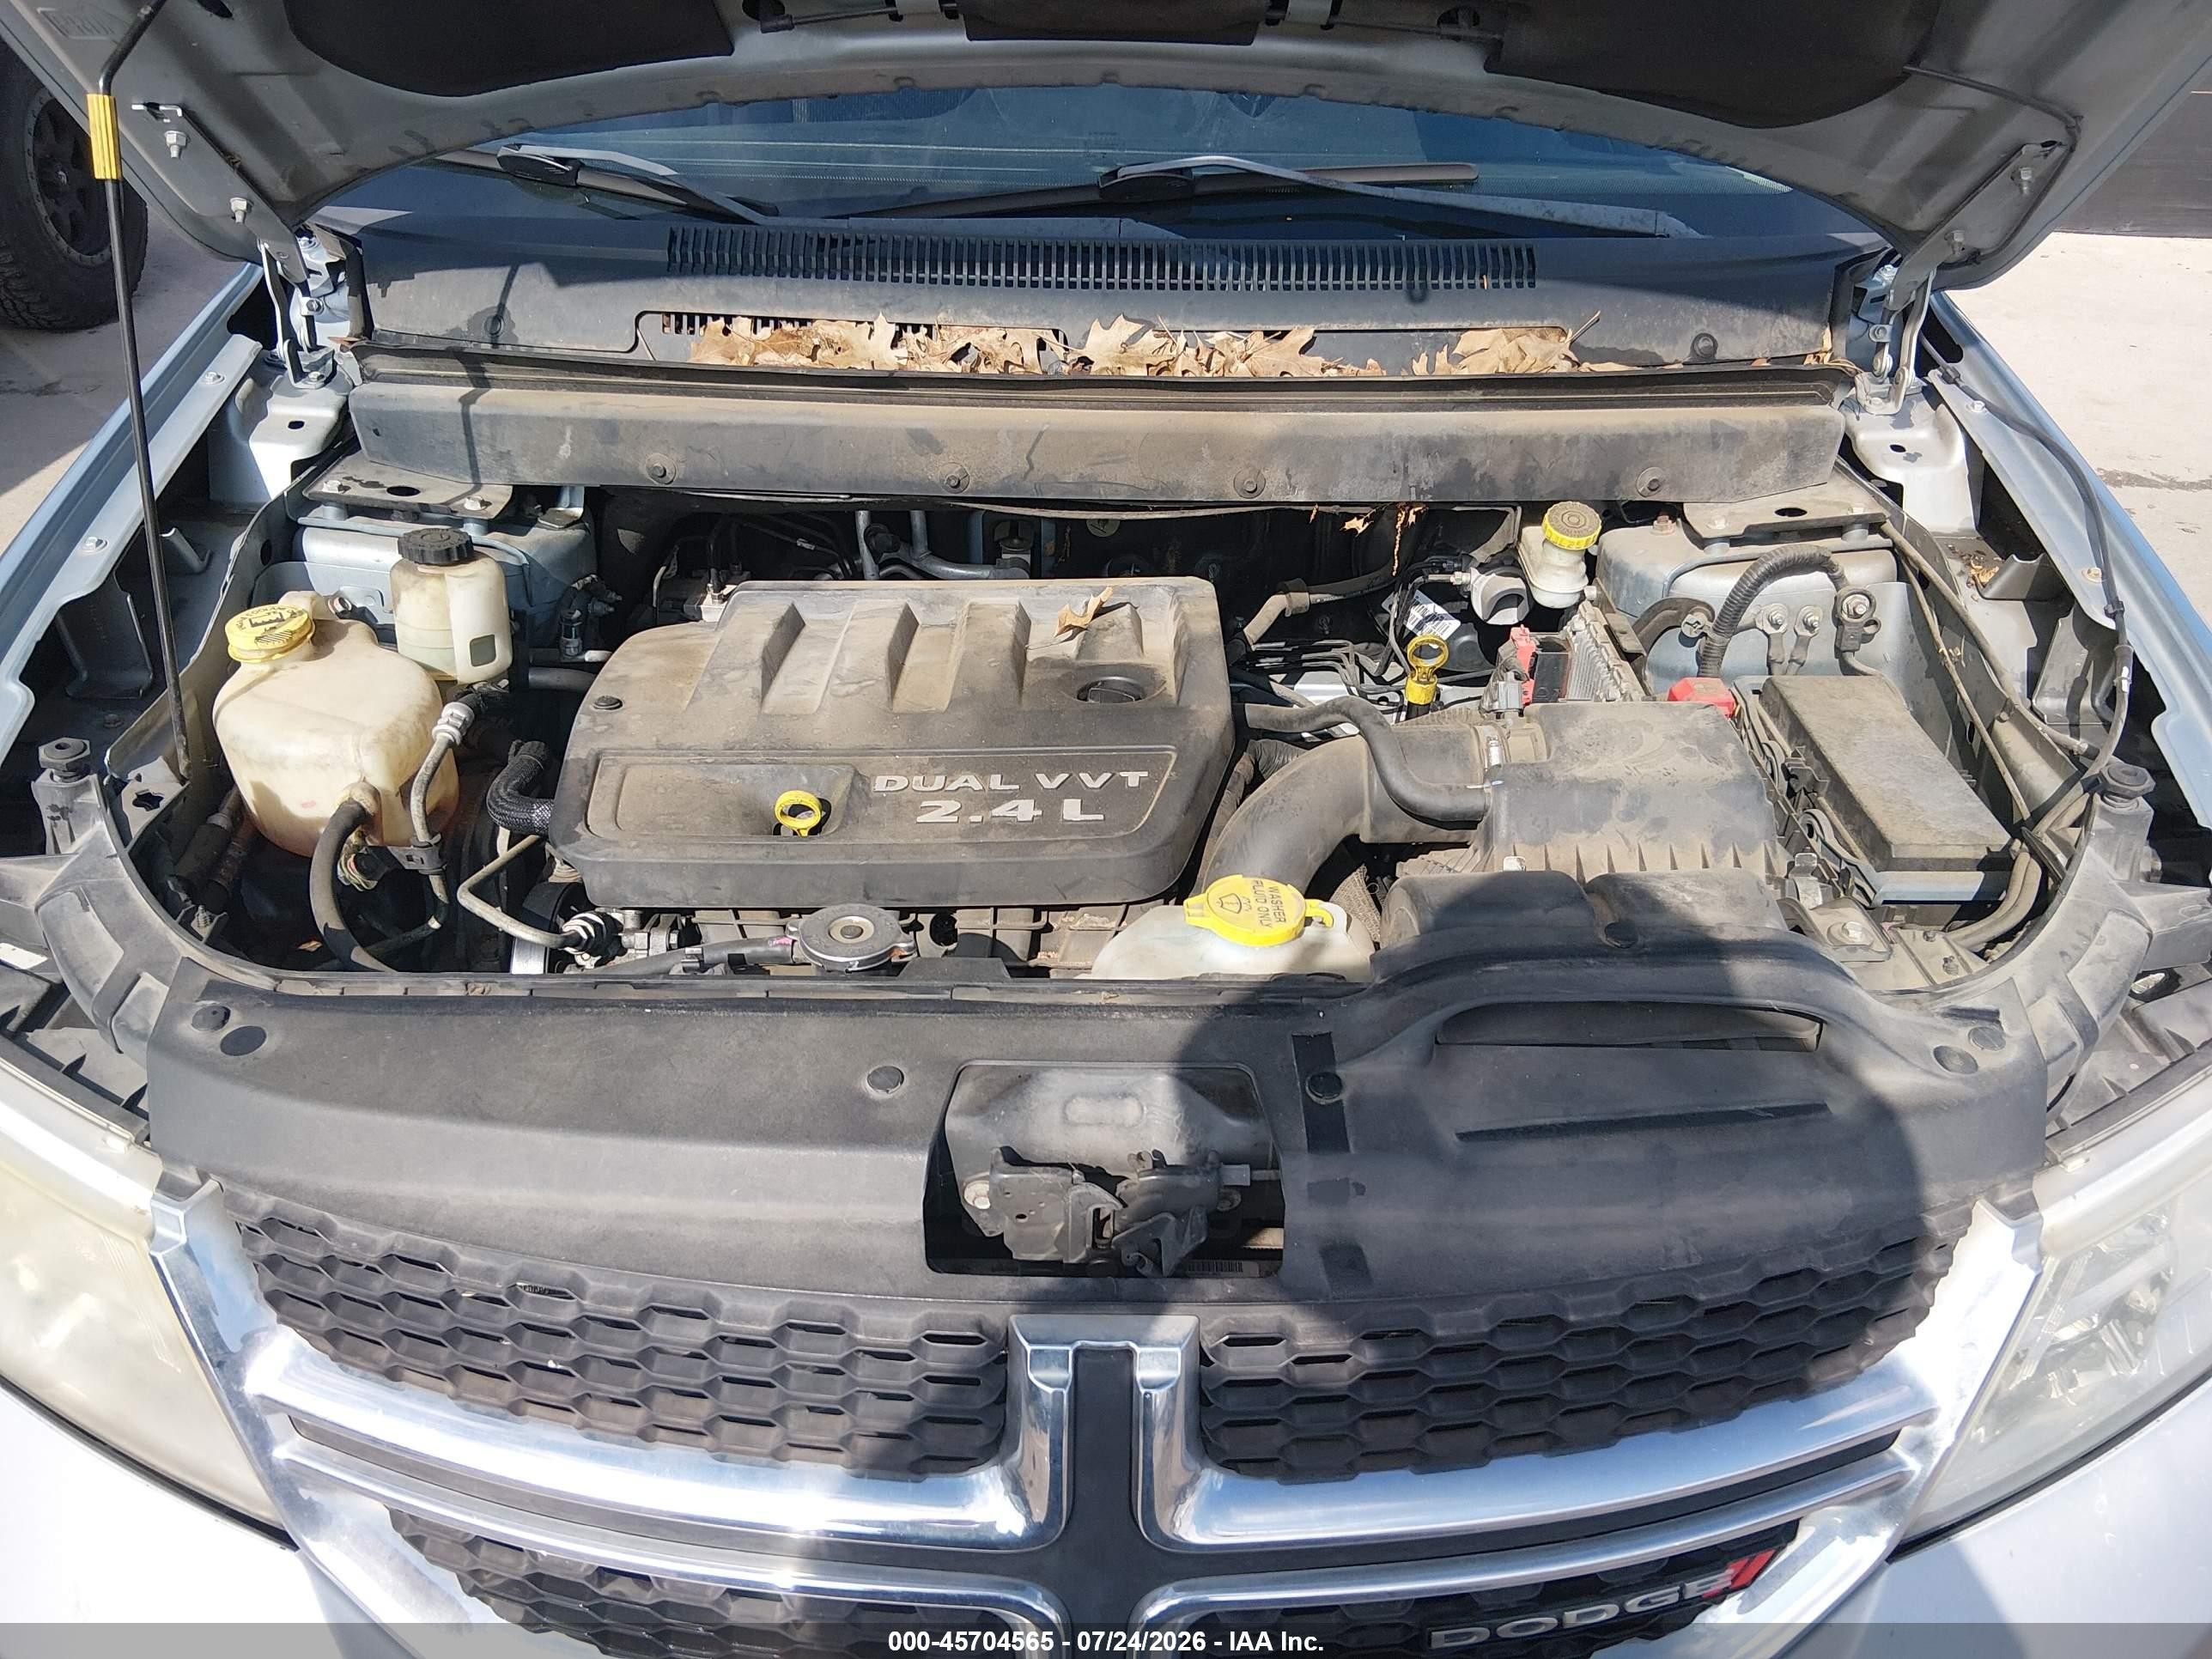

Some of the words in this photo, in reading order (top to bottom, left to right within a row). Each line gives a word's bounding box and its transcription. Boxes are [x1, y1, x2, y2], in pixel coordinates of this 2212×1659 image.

[872, 774, 1020, 792] DUAL
[1035, 771, 1149, 790] VVT
[915, 799, 1042, 823] 2.4
[1062, 799, 1104, 822] L
[1253, 879, 1267, 904] FLUID
[1269, 886, 1286, 923] WASHER
[1257, 906, 1273, 928] ONLY
[1430, 1567, 1737, 1650] DODGE
